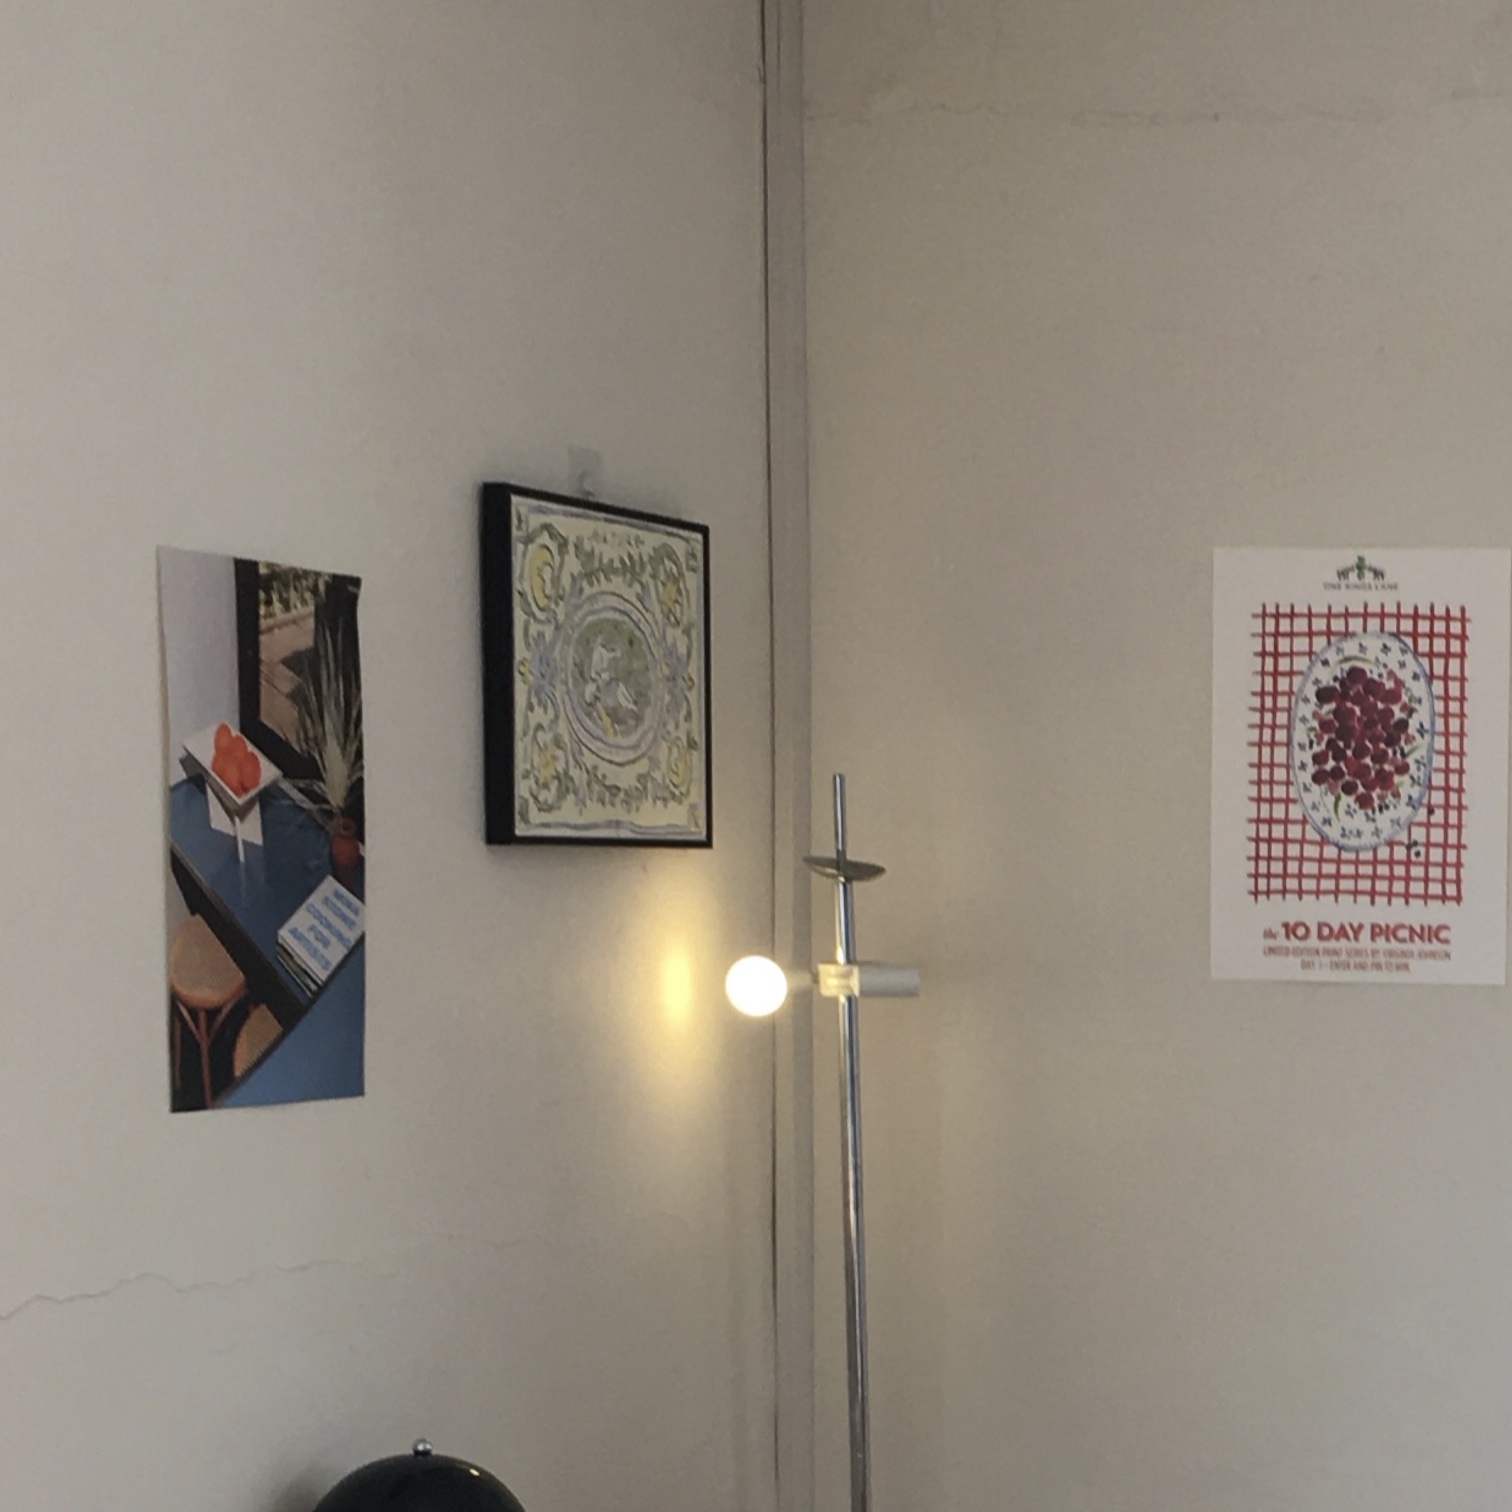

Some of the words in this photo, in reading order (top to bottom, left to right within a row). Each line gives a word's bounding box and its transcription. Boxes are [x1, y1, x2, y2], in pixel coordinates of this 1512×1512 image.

[1282, 921, 1311, 941] 10
[1317, 921, 1364, 942] DAY
[1370, 923, 1451, 944] PICNIC
